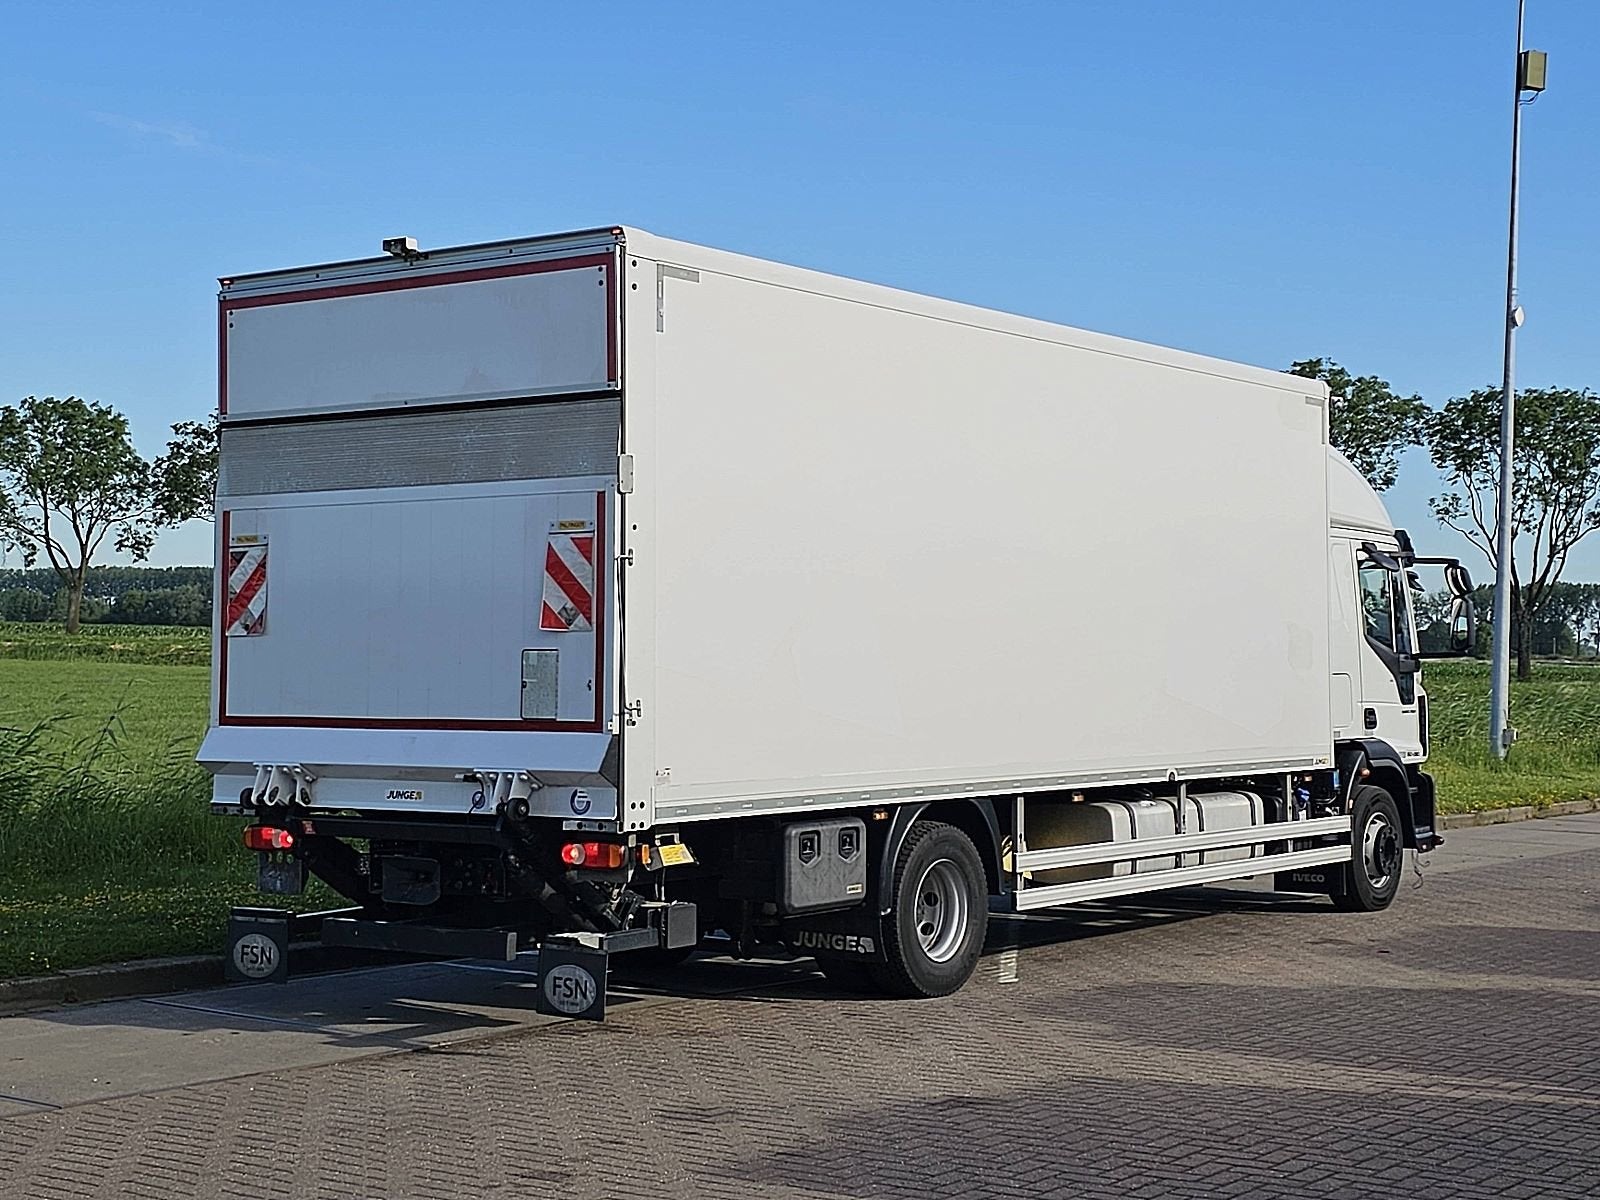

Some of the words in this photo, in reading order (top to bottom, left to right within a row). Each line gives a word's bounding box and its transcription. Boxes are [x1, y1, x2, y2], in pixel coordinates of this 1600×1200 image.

[1292, 873, 1325, 883] IVECO
[240, 944, 272, 965] FSN
[552, 976, 588, 1000] FSN
